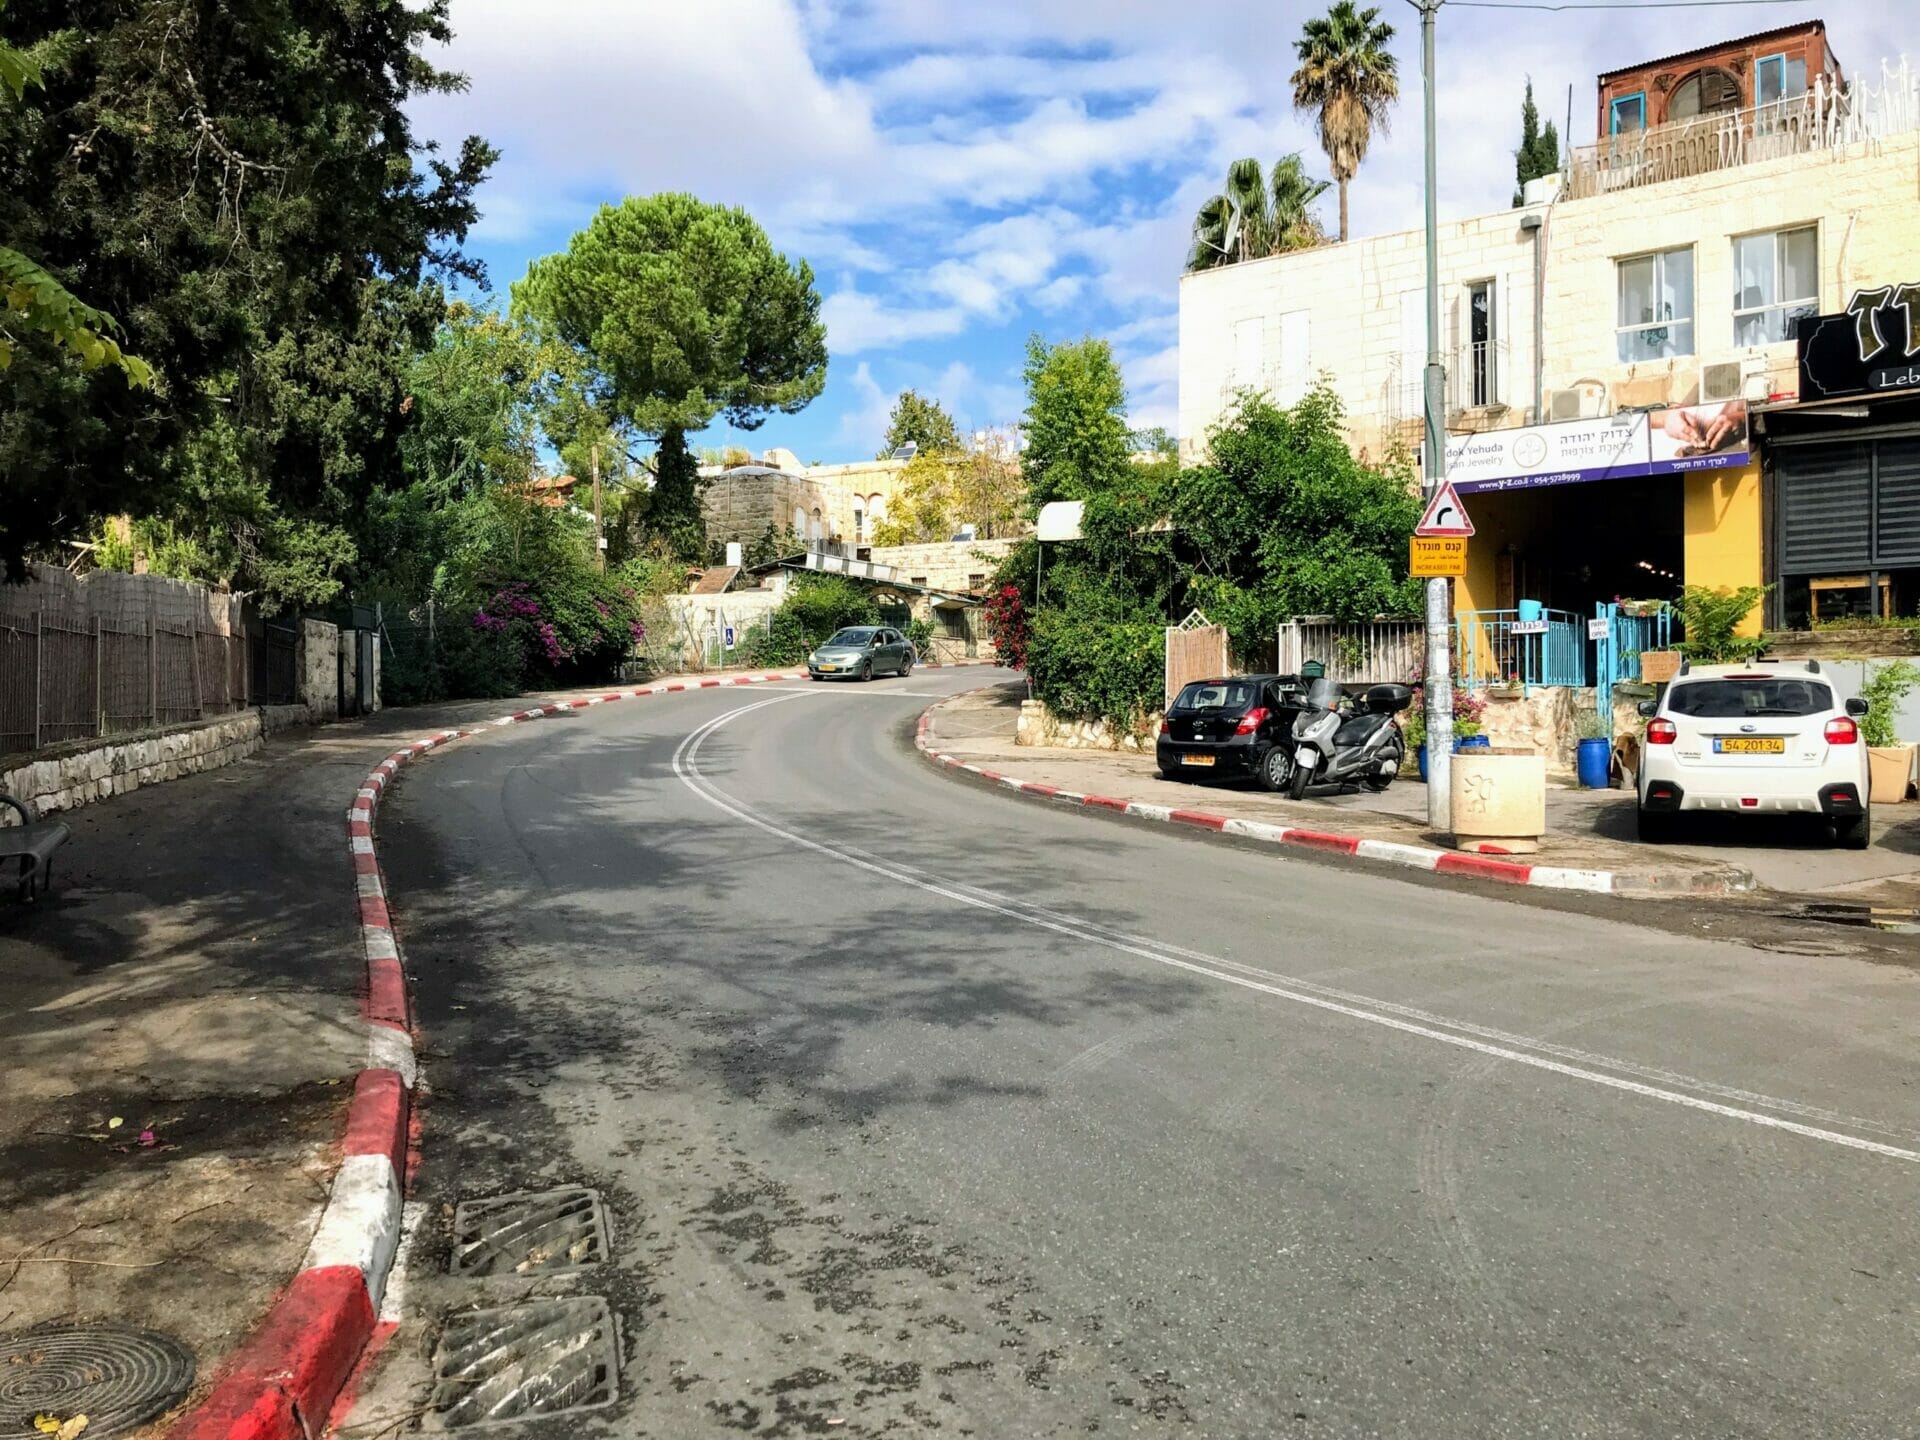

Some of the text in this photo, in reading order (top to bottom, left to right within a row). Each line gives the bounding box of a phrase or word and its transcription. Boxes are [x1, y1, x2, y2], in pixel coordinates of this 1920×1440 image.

[1560, 428, 1633, 444] צדוק יהודה
[1446, 443, 1503, 458] dok Yehuda
[1466, 455, 1504, 468] Jewelry
[1416, 541, 1462, 552] קנס מוגדל
